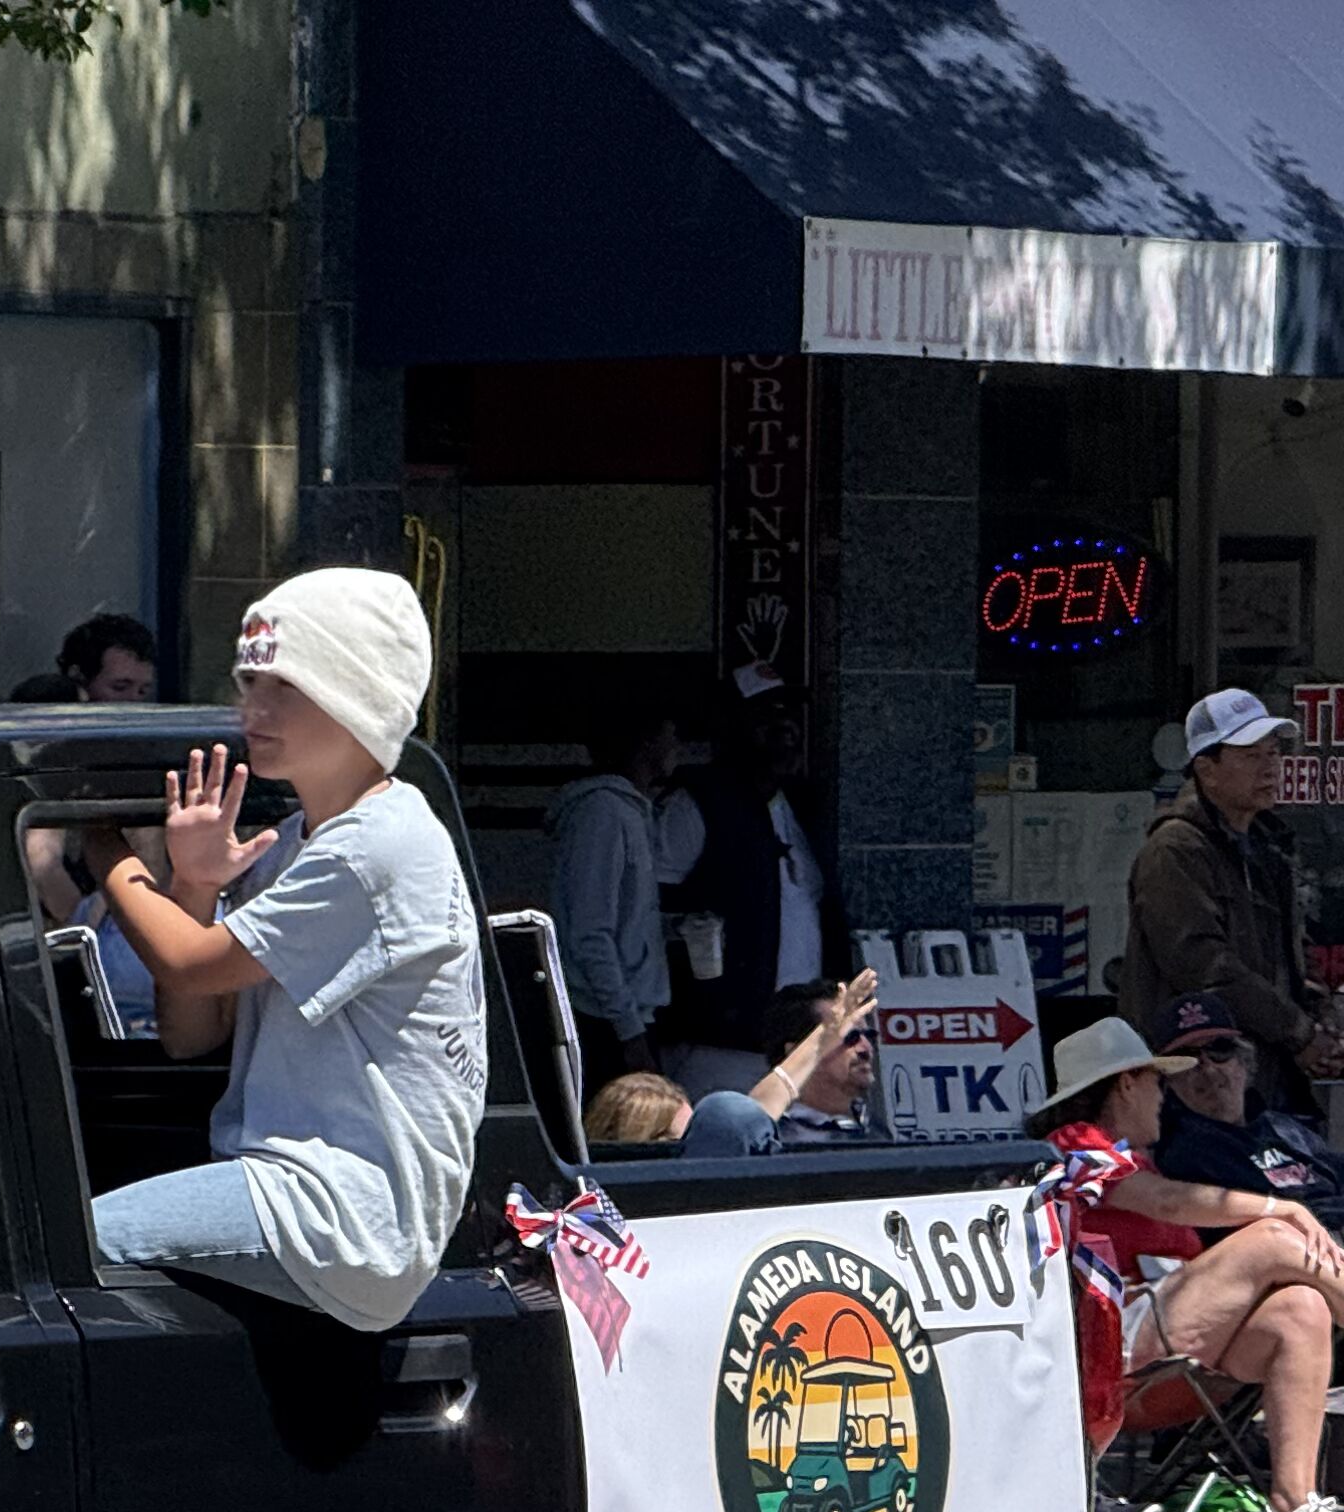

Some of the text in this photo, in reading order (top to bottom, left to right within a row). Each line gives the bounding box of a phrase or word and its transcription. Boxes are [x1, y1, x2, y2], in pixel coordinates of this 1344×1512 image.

[982, 556, 1148, 632] OPEN
[1277, 756, 1321, 804] BER
[886, 1012, 998, 1040] OPEN
[919, 1064, 1010, 1114] TK
[904, 1218, 1015, 1313] 160
[723, 1250, 930, 1404] ALAMEDA ISLAND
